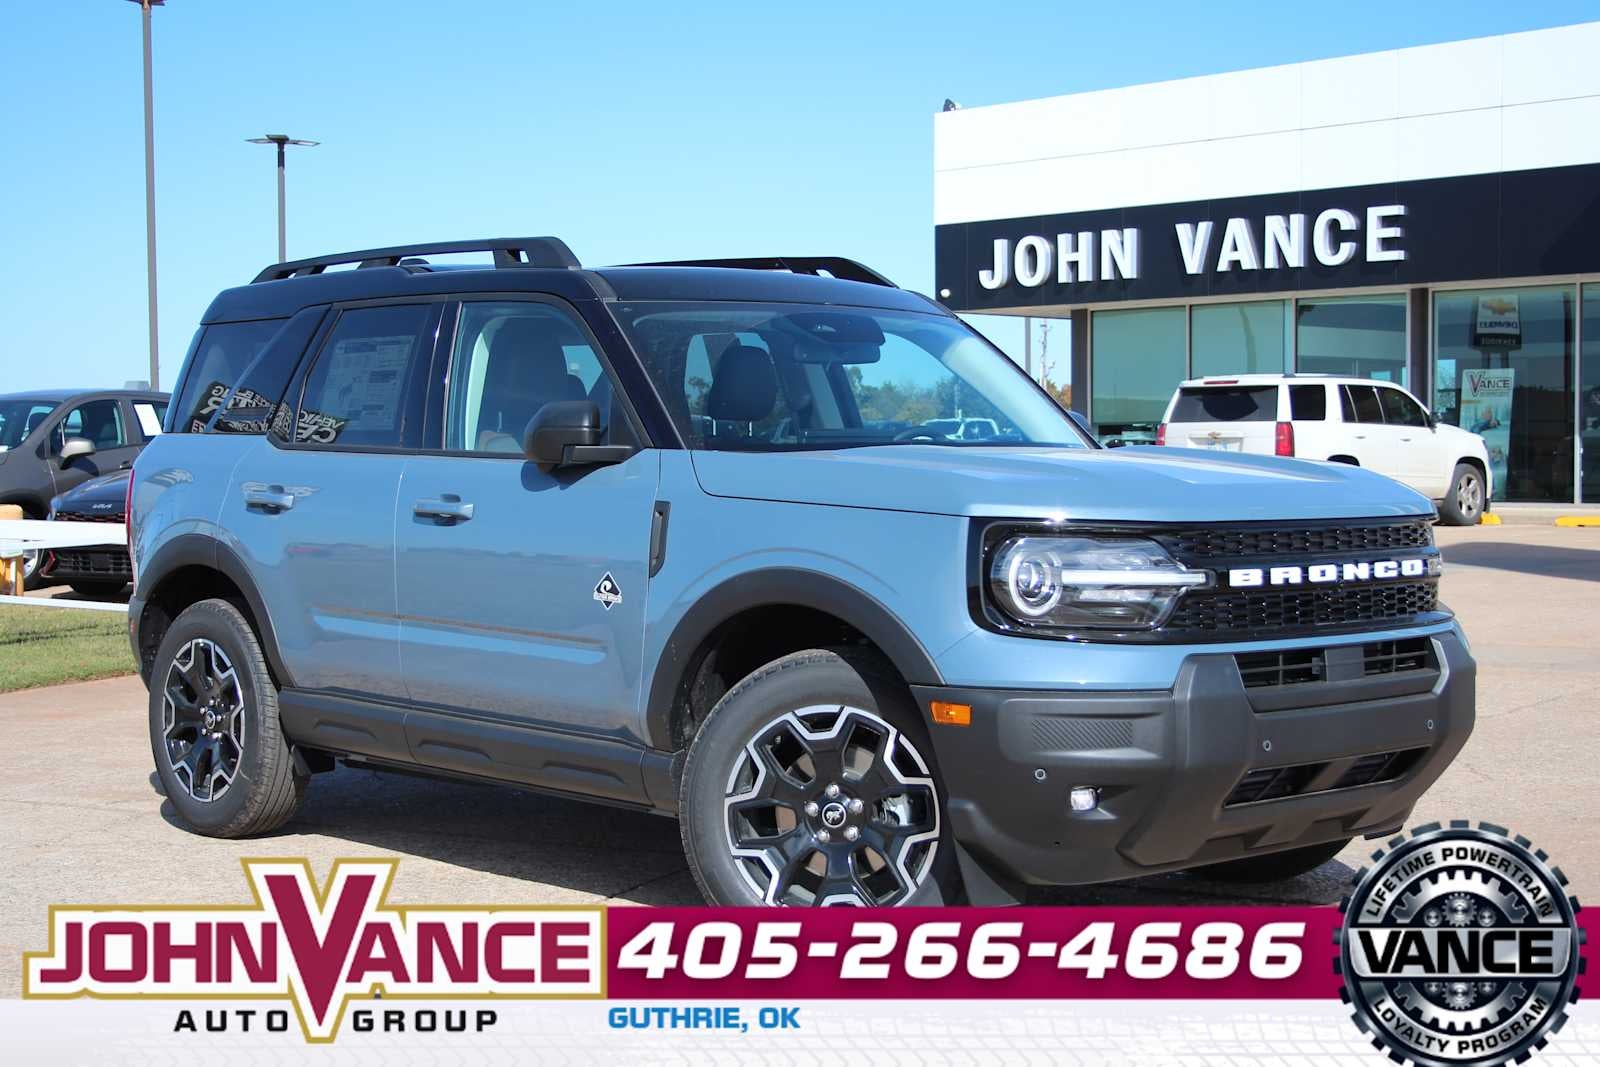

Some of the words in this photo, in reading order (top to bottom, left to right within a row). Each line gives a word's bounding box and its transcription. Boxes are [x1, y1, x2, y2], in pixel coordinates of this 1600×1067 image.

[978, 227, 1139, 290] JOHN
[1175, 204, 1406, 275] VANCE
[1469, 374, 1510, 394] VANCE
[1228, 559, 1424, 587] BRONCO
